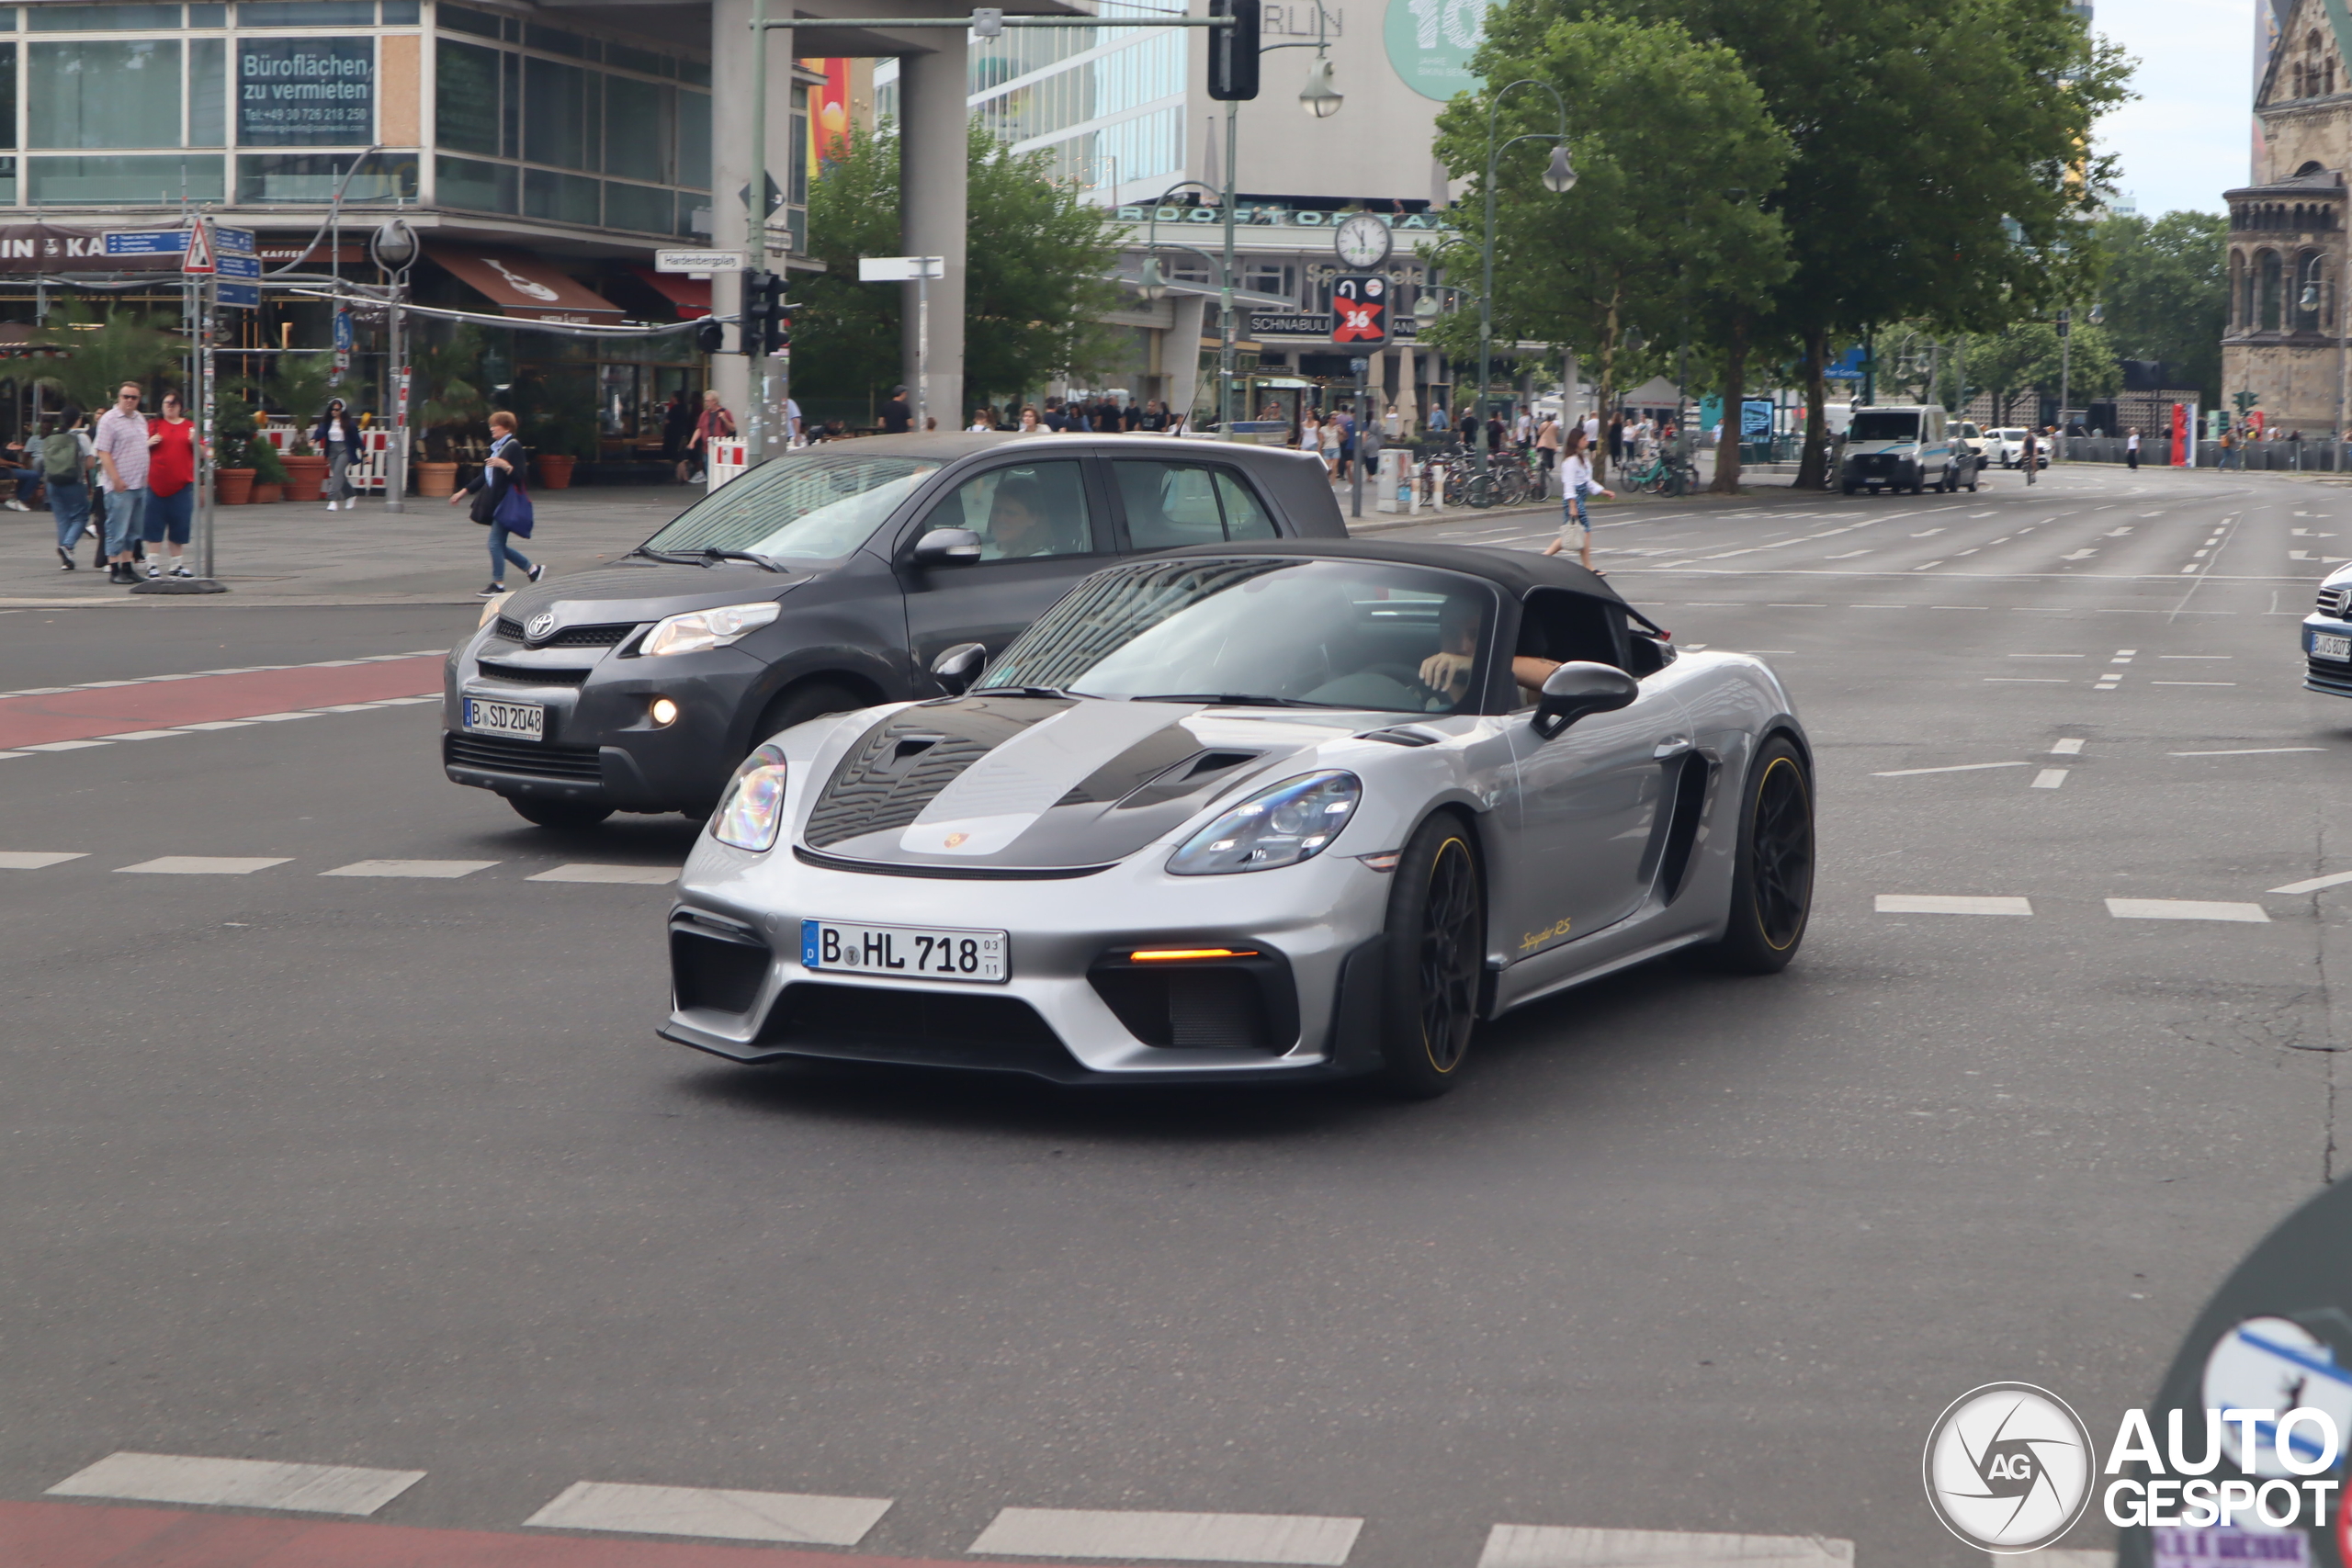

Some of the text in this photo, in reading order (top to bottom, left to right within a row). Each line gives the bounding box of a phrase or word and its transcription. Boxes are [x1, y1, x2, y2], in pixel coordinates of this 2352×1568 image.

[243, 53, 367, 76] Büroflächen
[243, 79, 367, 99] zu vermieten
[1346, 310, 1370, 328] 36
[471, 703, 481, 725] B
[490, 705, 507, 728] SD
[510, 707, 542, 733] 2048
[808, 928, 999, 973] D B HL 718 03
[985, 964, 998, 975] 11
